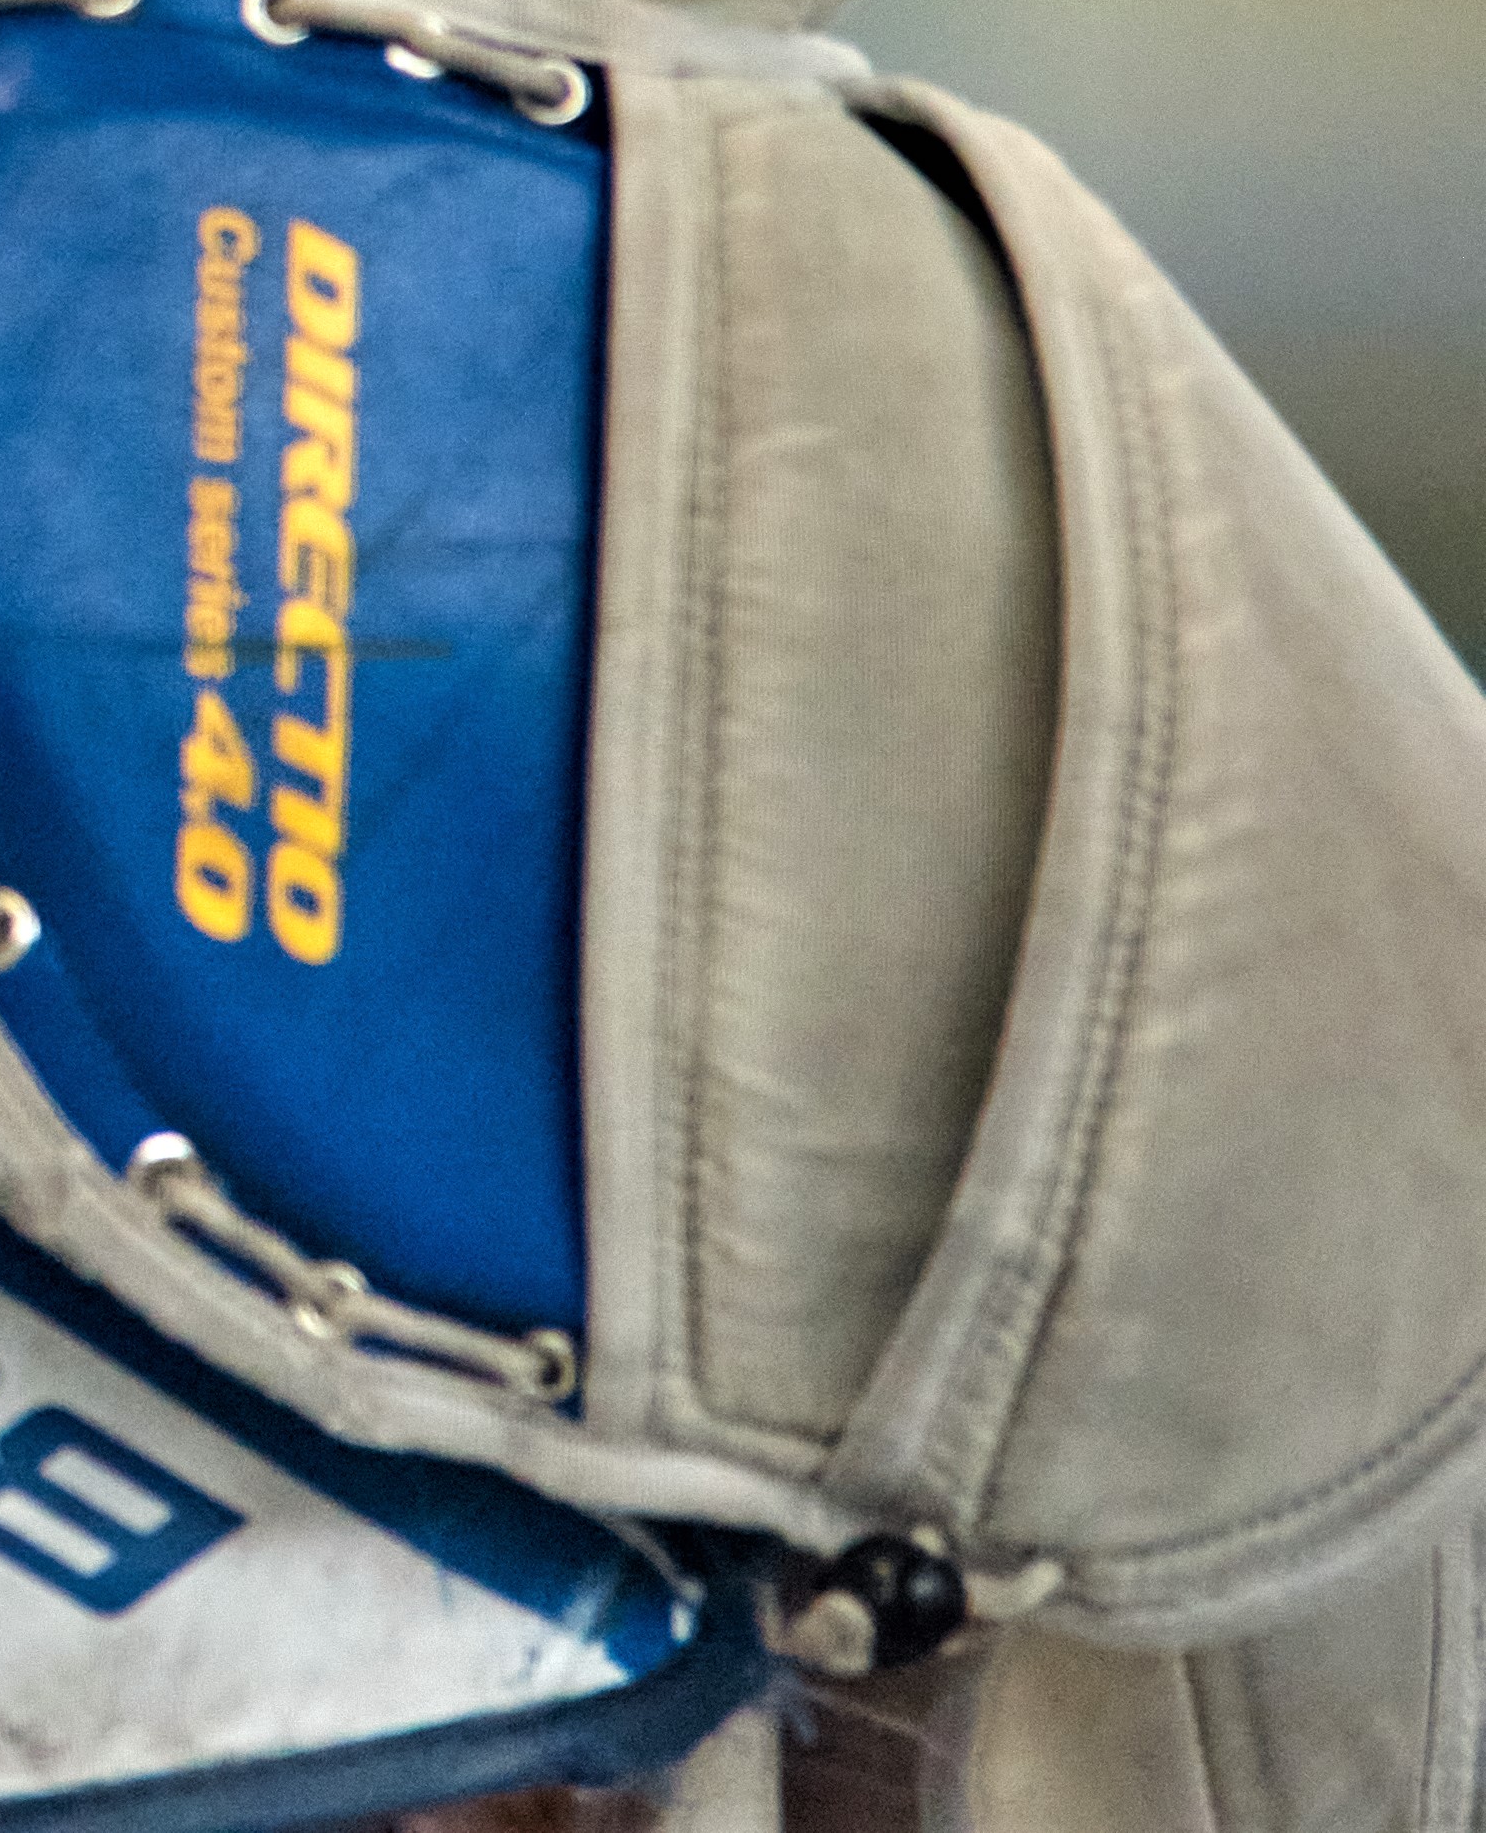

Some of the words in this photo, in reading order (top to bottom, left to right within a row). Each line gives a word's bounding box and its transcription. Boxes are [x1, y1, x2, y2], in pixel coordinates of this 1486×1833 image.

[191, 204, 262, 465] Custom
[265, 217, 361, 968] DIRECTIO
[174, 688, 257, 944] 4.0
